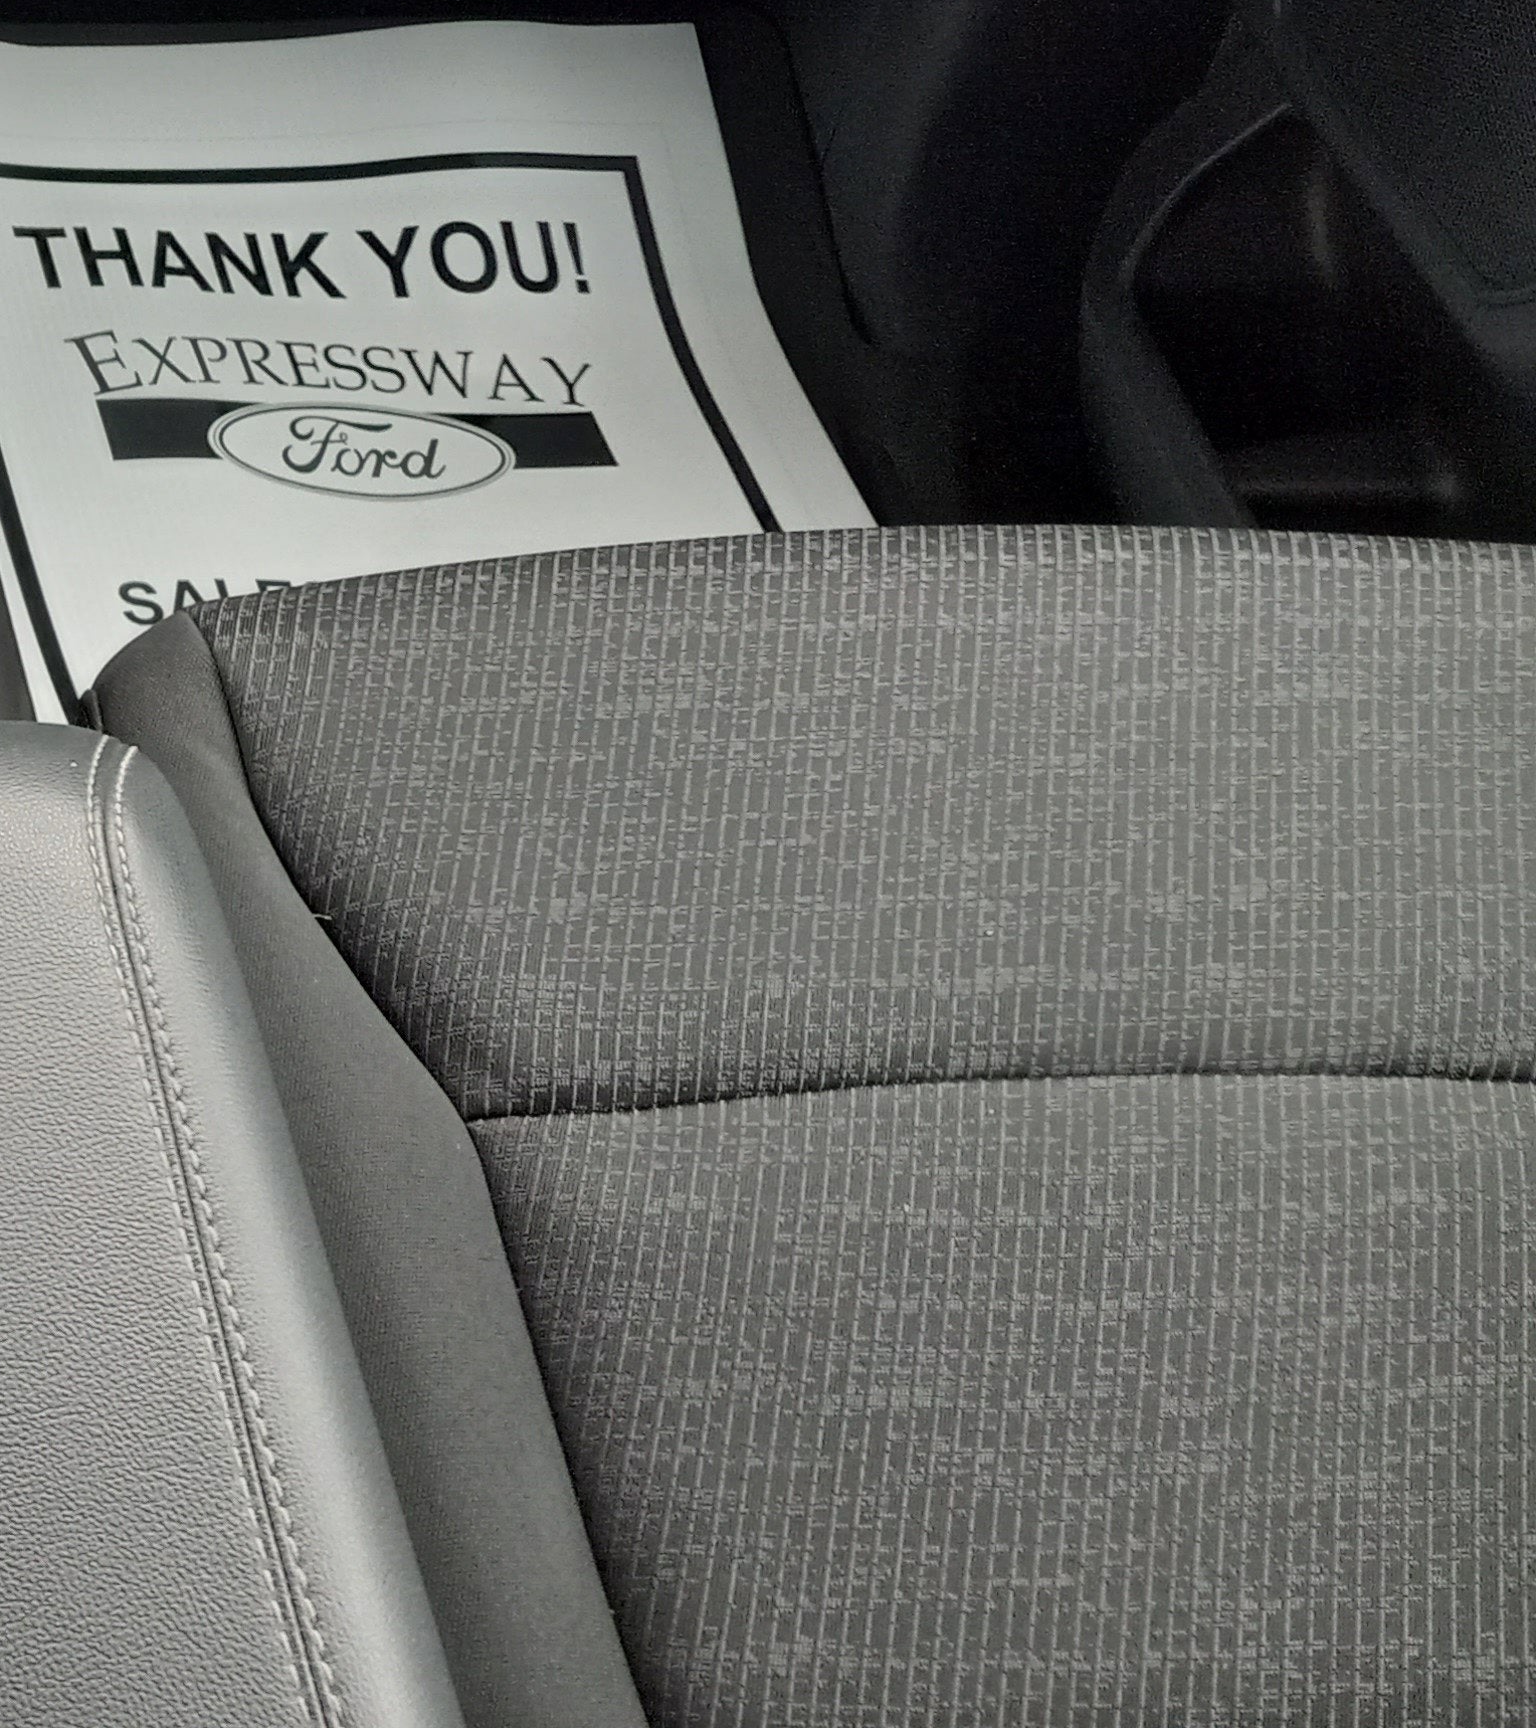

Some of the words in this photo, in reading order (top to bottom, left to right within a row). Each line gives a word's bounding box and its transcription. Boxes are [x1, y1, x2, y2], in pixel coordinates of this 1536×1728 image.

[12, 224, 347, 300] THANK
[356, 219, 592, 298] YOU!
[65, 328, 592, 409] EXPRESSWAY
[281, 414, 447, 483] Ford
